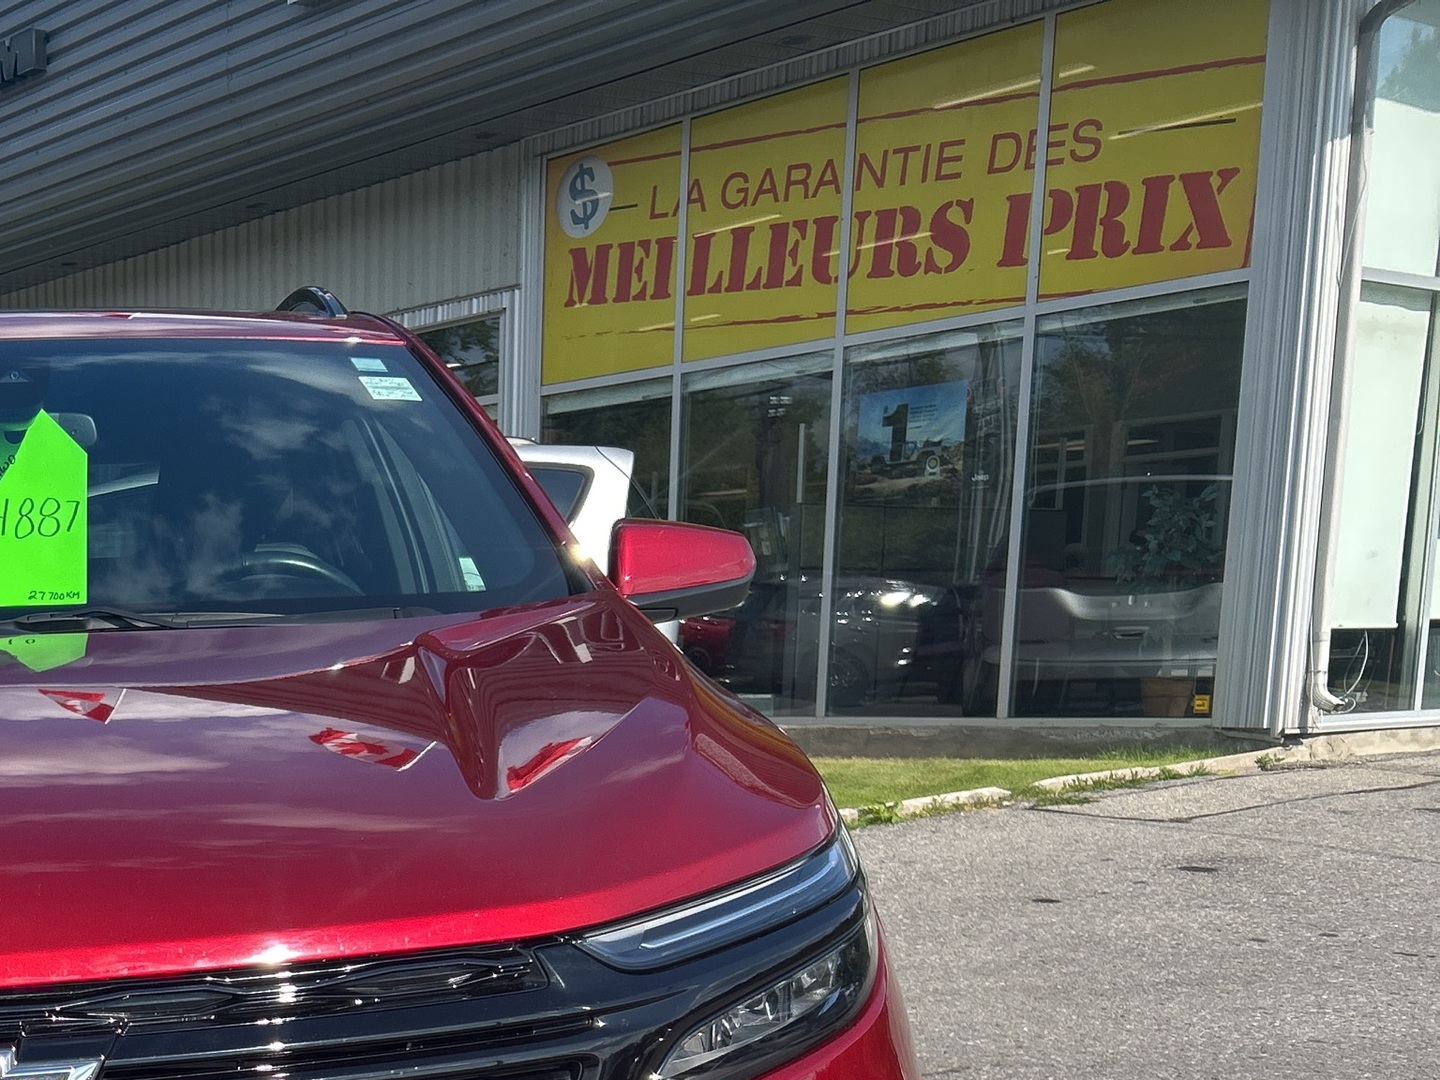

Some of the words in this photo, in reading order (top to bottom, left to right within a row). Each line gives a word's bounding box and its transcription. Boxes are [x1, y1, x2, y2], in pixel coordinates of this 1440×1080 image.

[649, 178, 707, 220] LA
[720, 138, 966, 211] GARANTIE
[987, 118, 1104, 175] DES
[563, 197, 975, 308] MEILLEURS
[996, 166, 1241, 268] PRIX
